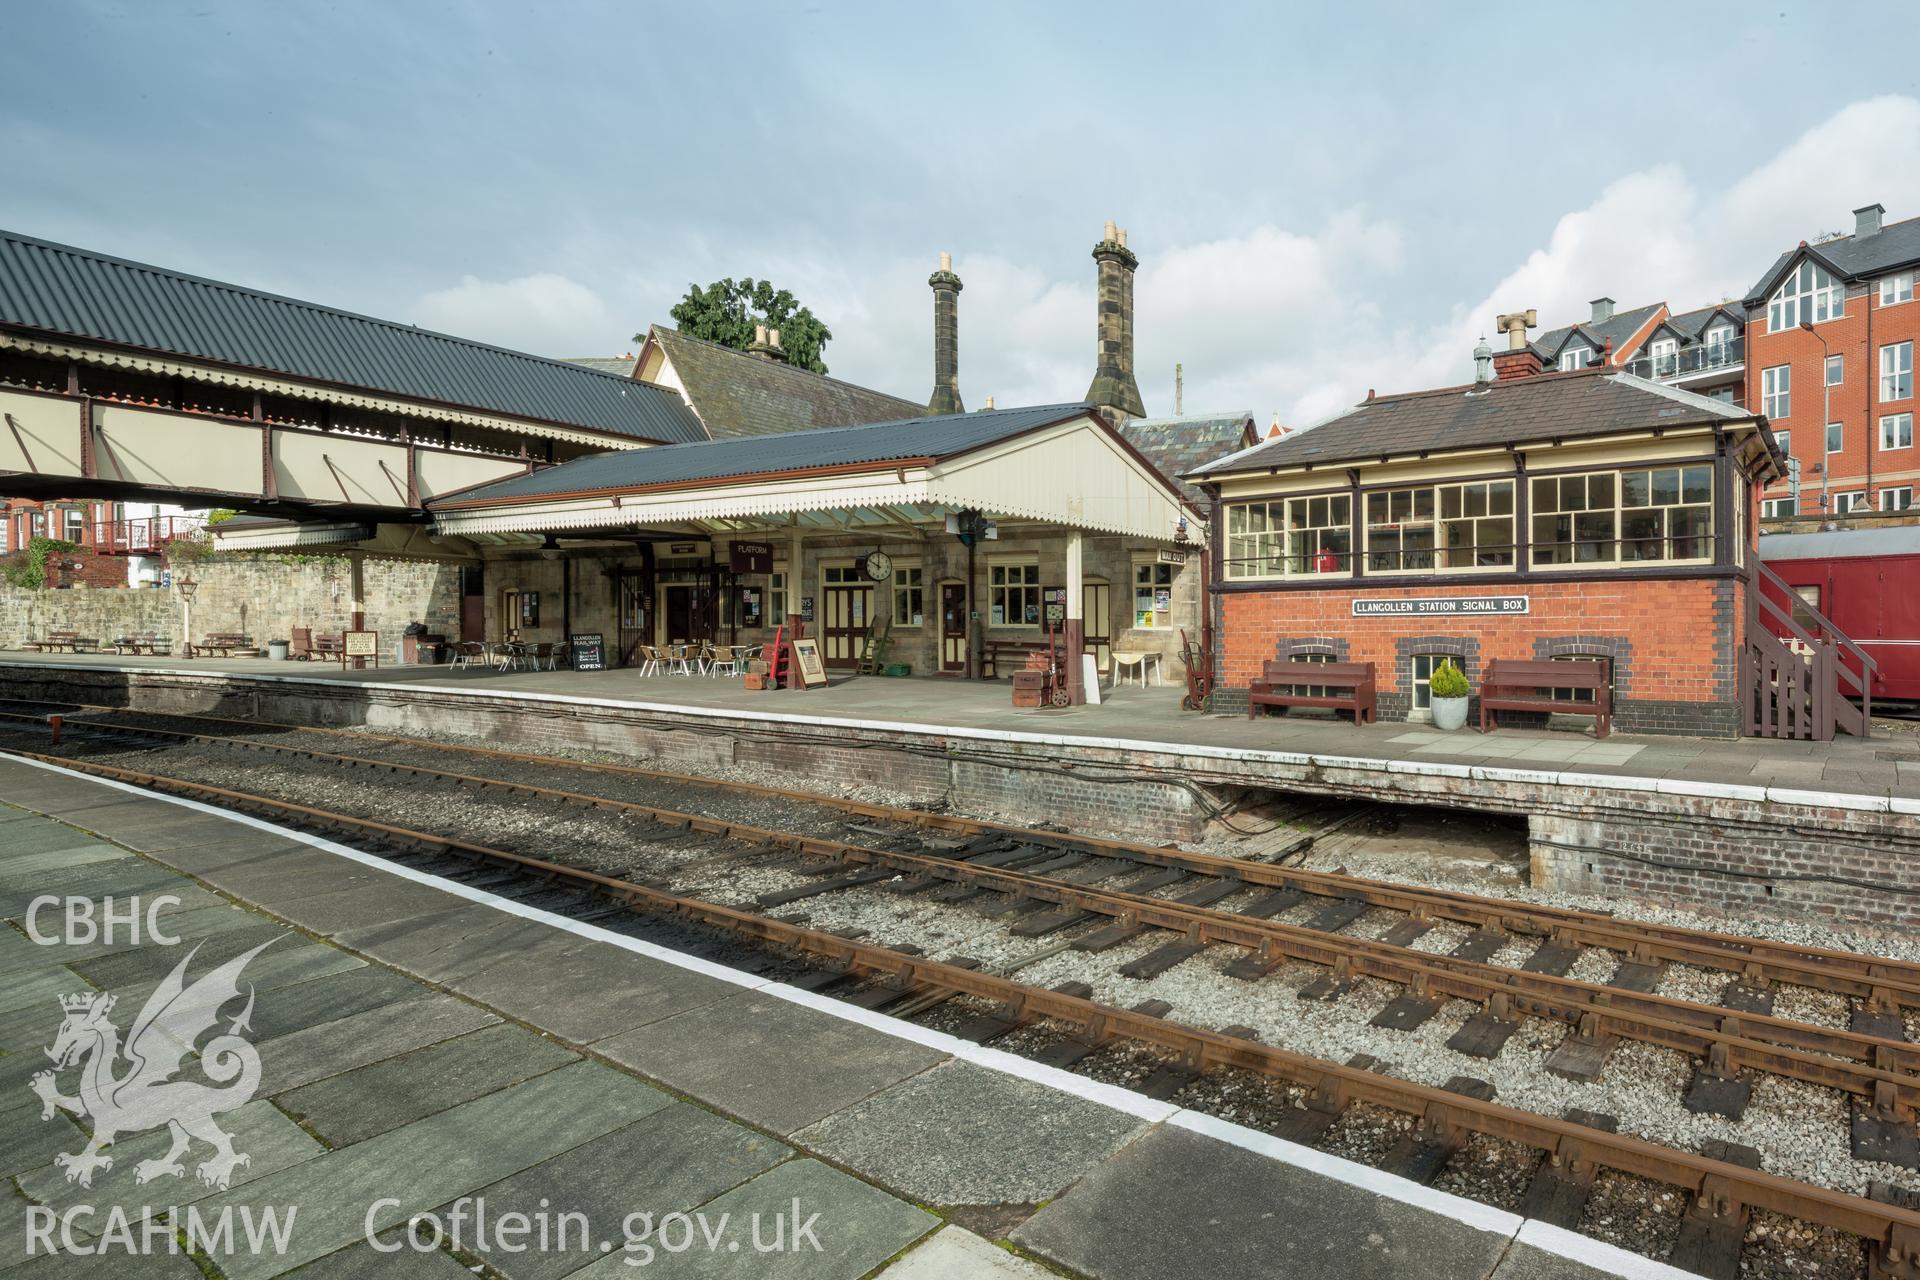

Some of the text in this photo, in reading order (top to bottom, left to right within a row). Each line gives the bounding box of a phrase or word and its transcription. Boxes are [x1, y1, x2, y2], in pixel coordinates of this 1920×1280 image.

[738, 545, 767, 554] PLATFORM
[1162, 551, 1184, 562] WAY OUT
[1357, 600, 1522, 612] LLANGOLLEN STATION SIGNAL BOX
